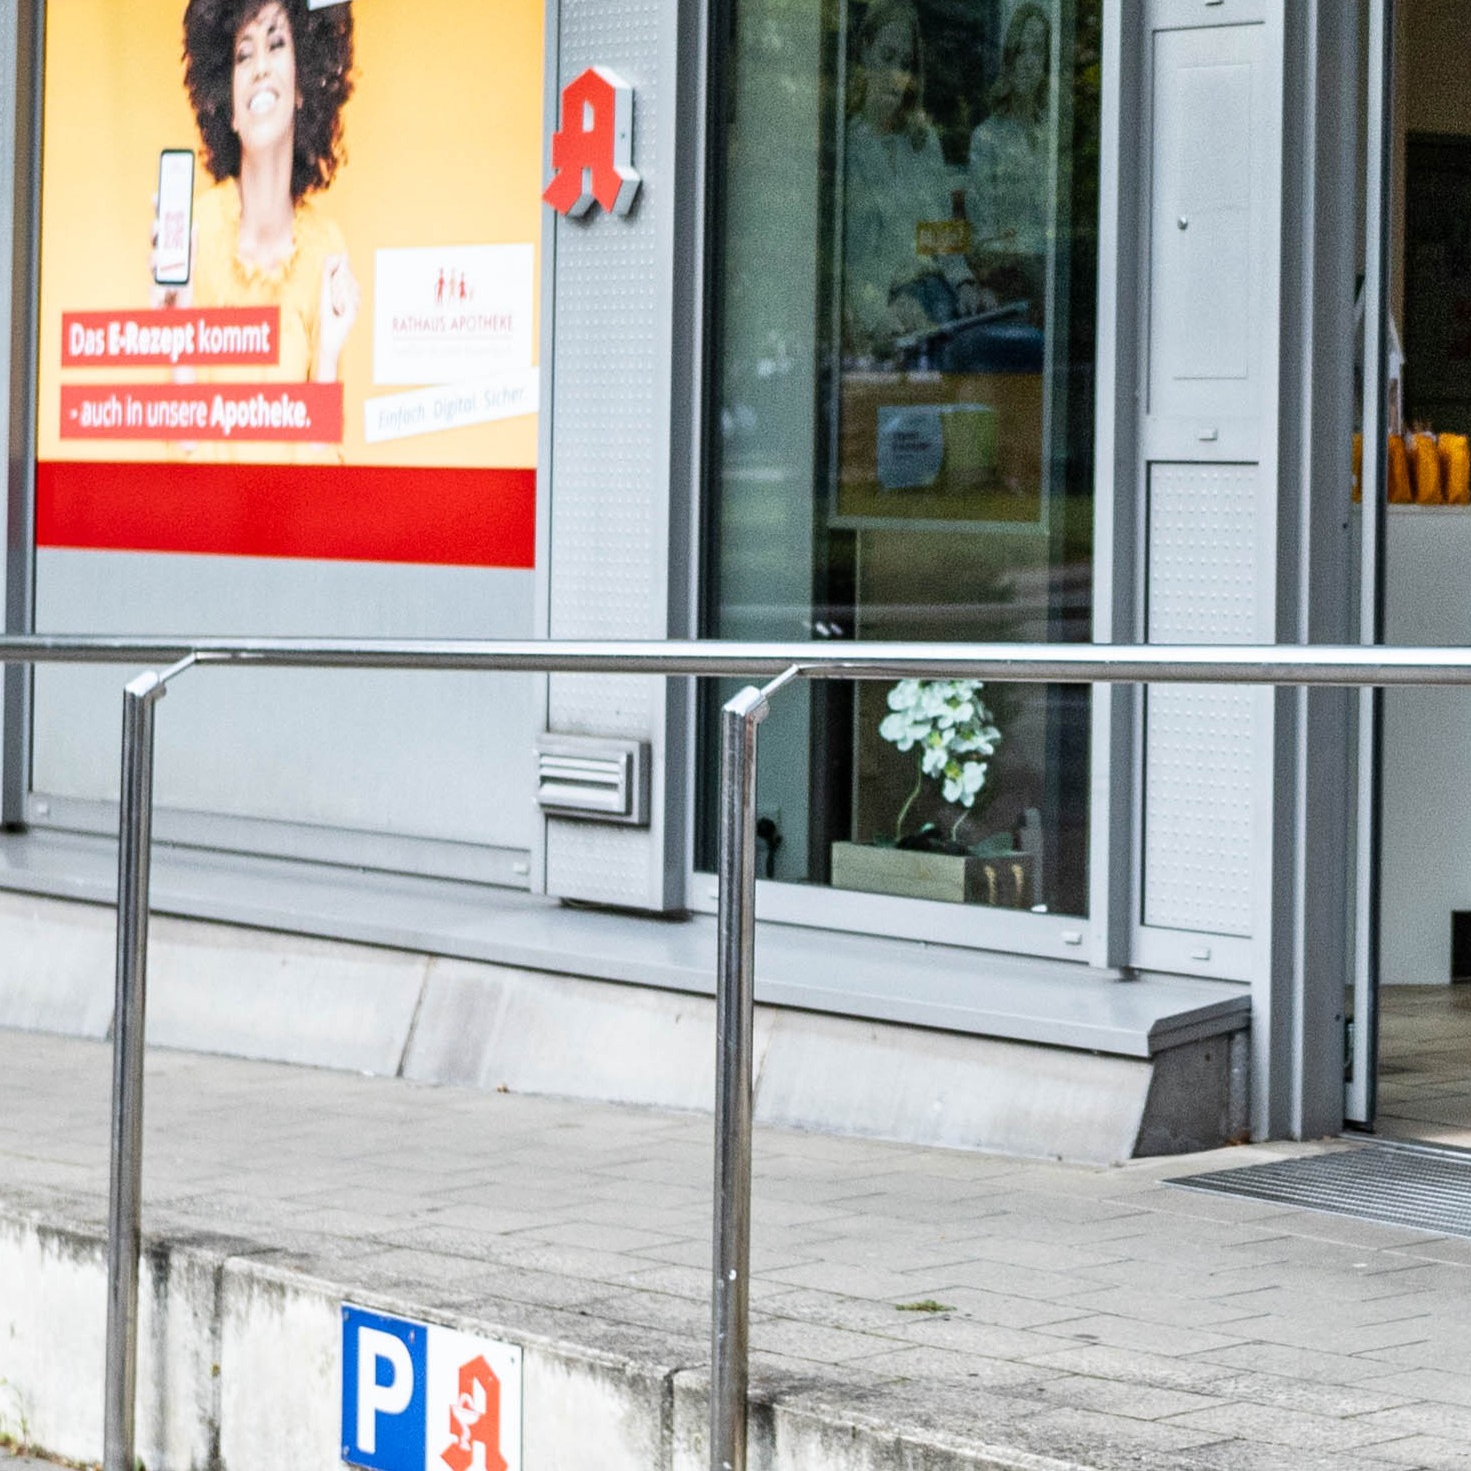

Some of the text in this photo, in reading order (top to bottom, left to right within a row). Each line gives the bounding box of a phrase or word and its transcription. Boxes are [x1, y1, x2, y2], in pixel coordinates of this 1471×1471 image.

[69, 318, 271, 363] Das E-Rezept kommt
[392, 314, 513, 333] RATHAUS APOTHEKE
[80, 395, 123, 427] auch
[126, 395, 143, 426] in
[147, 400, 208, 427] unsere
[210, 394, 311, 436] Apotheke.
[357, 1325, 415, 1454] P
